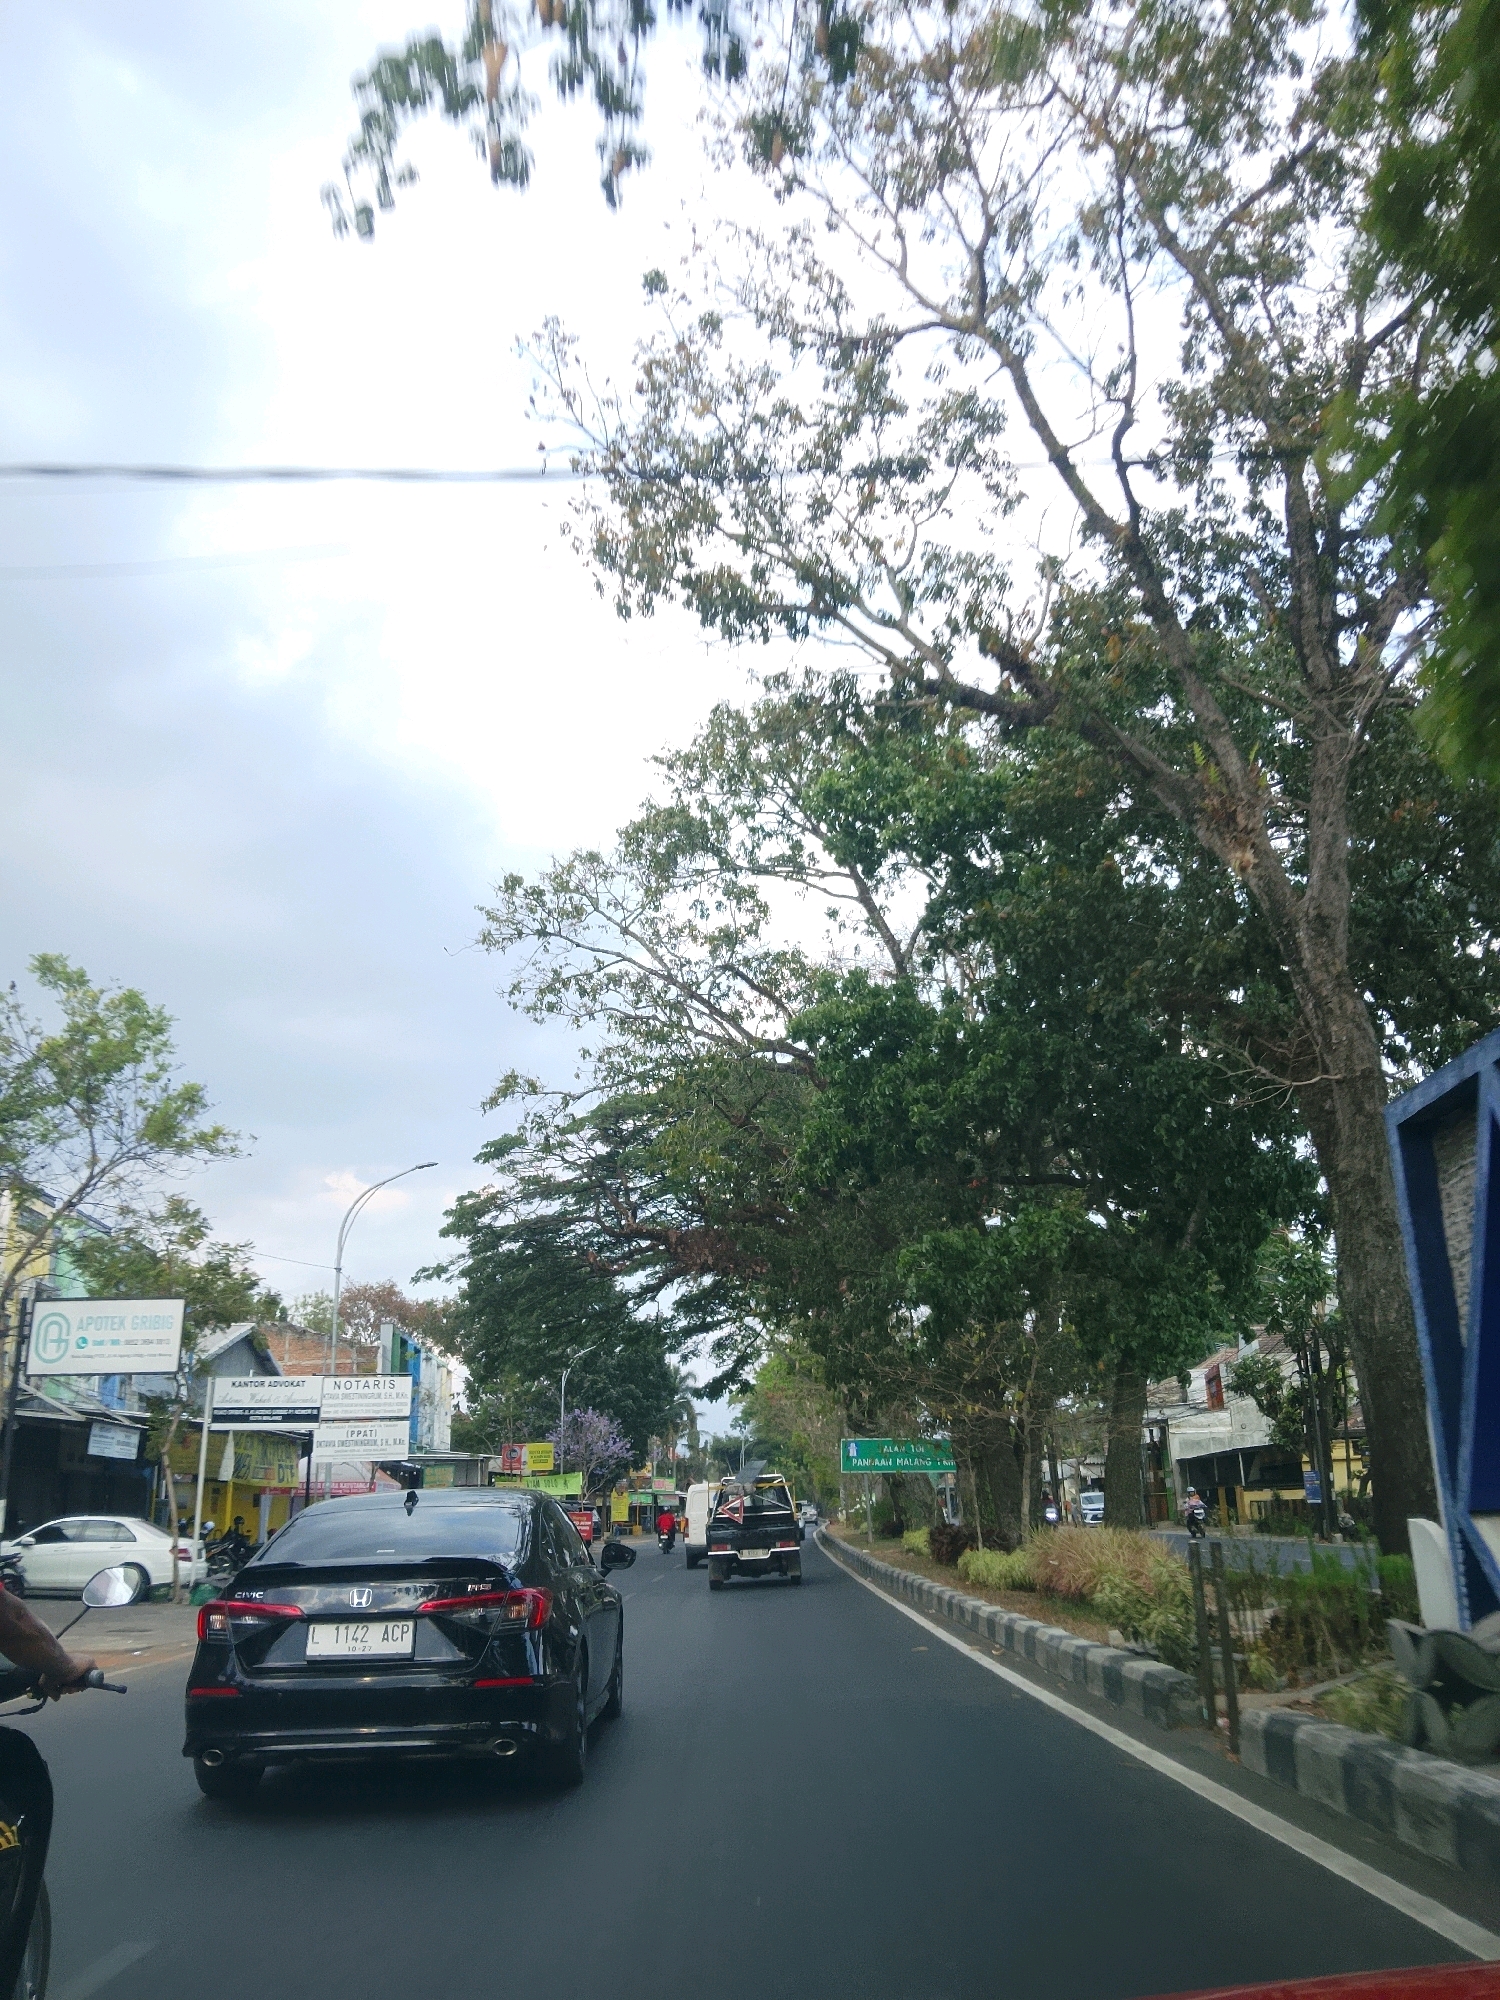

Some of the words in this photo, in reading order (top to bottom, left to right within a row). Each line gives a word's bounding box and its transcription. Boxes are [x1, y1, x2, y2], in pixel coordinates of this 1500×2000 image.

[76, 1315, 127, 1331] APOTEK
[131, 1314, 174, 1330] GRIBIG
[231, 1380, 265, 1388] KANTOR
[267, 1380, 306, 1388] ADVOKAT
[333, 1379, 396, 1391] NOTARIS
[346, 1429, 378, 1438] (PPAT)
[896, 1457, 932, 1466] MALANG
[234, 1591, 264, 1599] CIVIC
[311, 1625, 320, 1645] L
[334, 1624, 369, 1644] 1142
[381, 1621, 410, 1643] ACP
